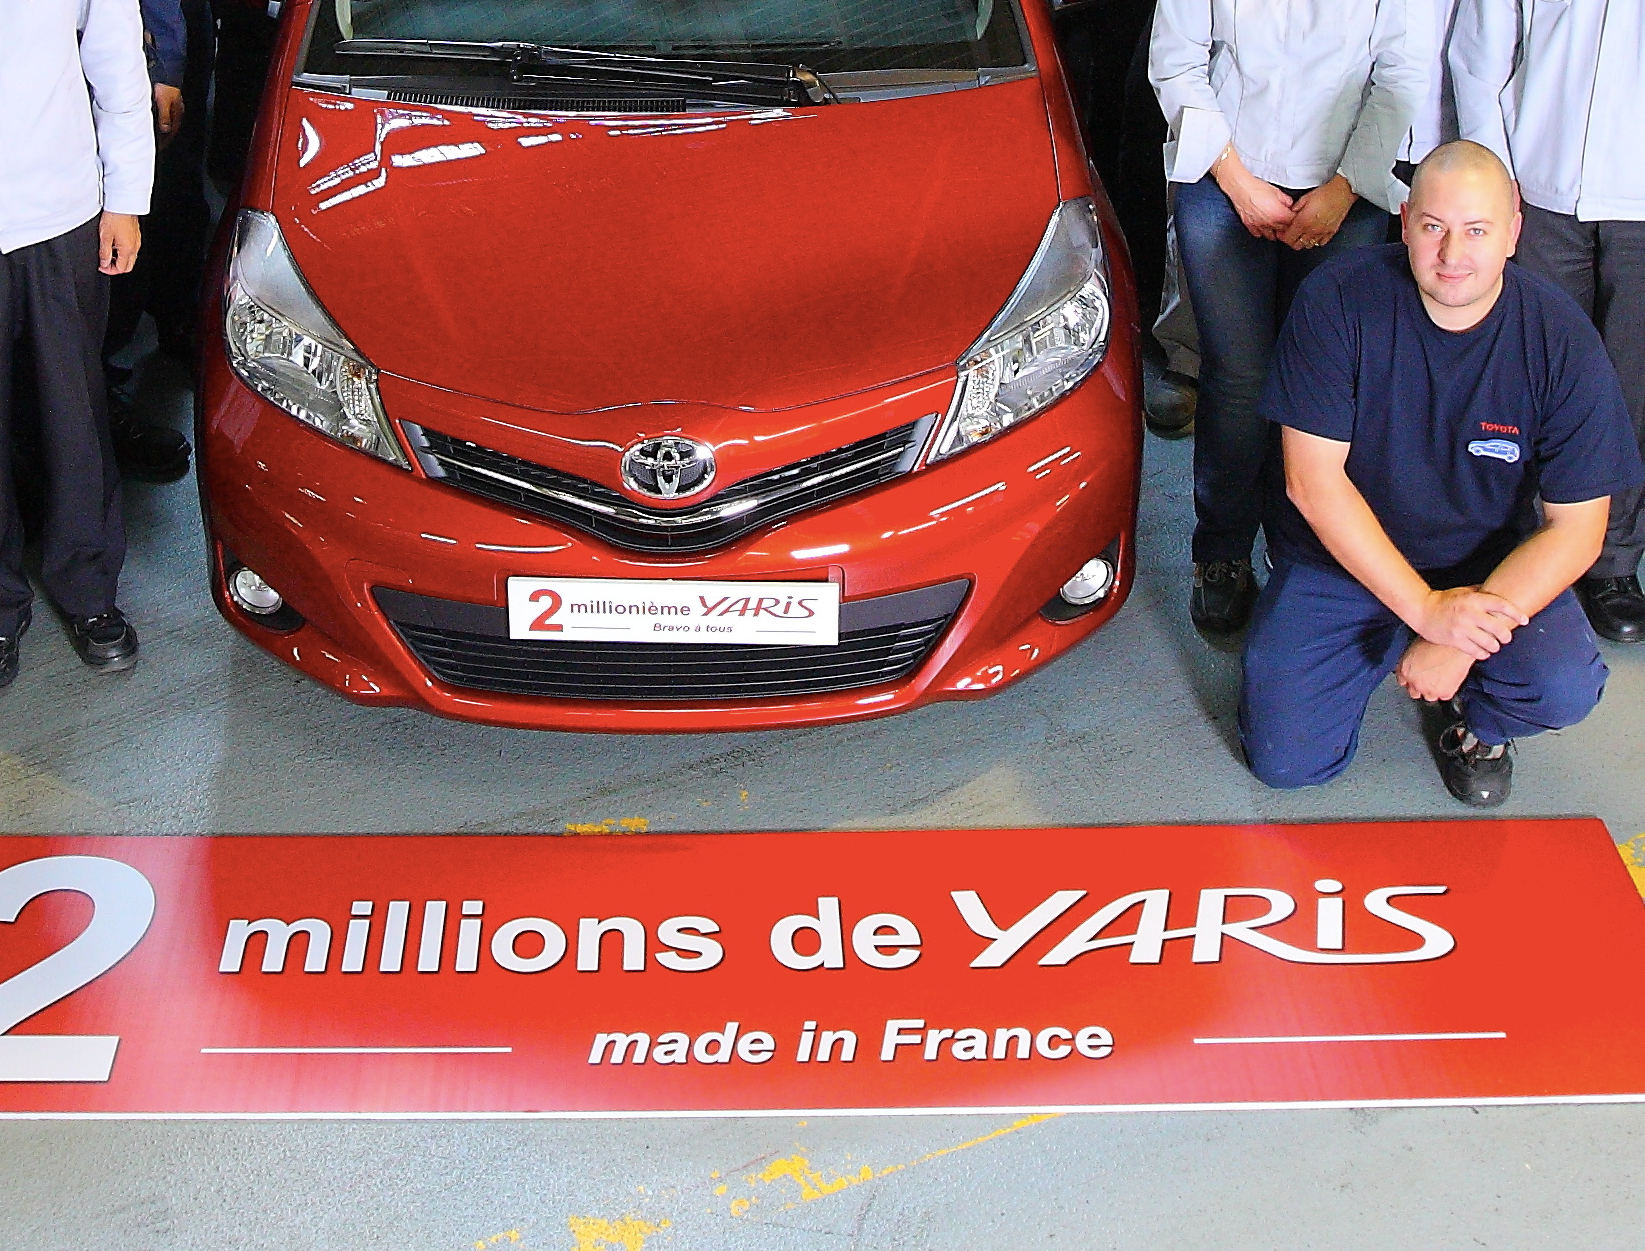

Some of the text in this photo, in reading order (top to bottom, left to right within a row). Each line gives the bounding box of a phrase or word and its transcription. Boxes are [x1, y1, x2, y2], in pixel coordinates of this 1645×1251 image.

[1479, 421, 1520, 436] TOYOTA
[528, 588, 564, 633] 2
[570, 599, 691, 616] millionième
[653, 622, 734, 634] Bravo à tous
[218, 900, 725, 974] millions
[769, 896, 923, 971] de
[586, 1018, 1115, 1066] made in France
